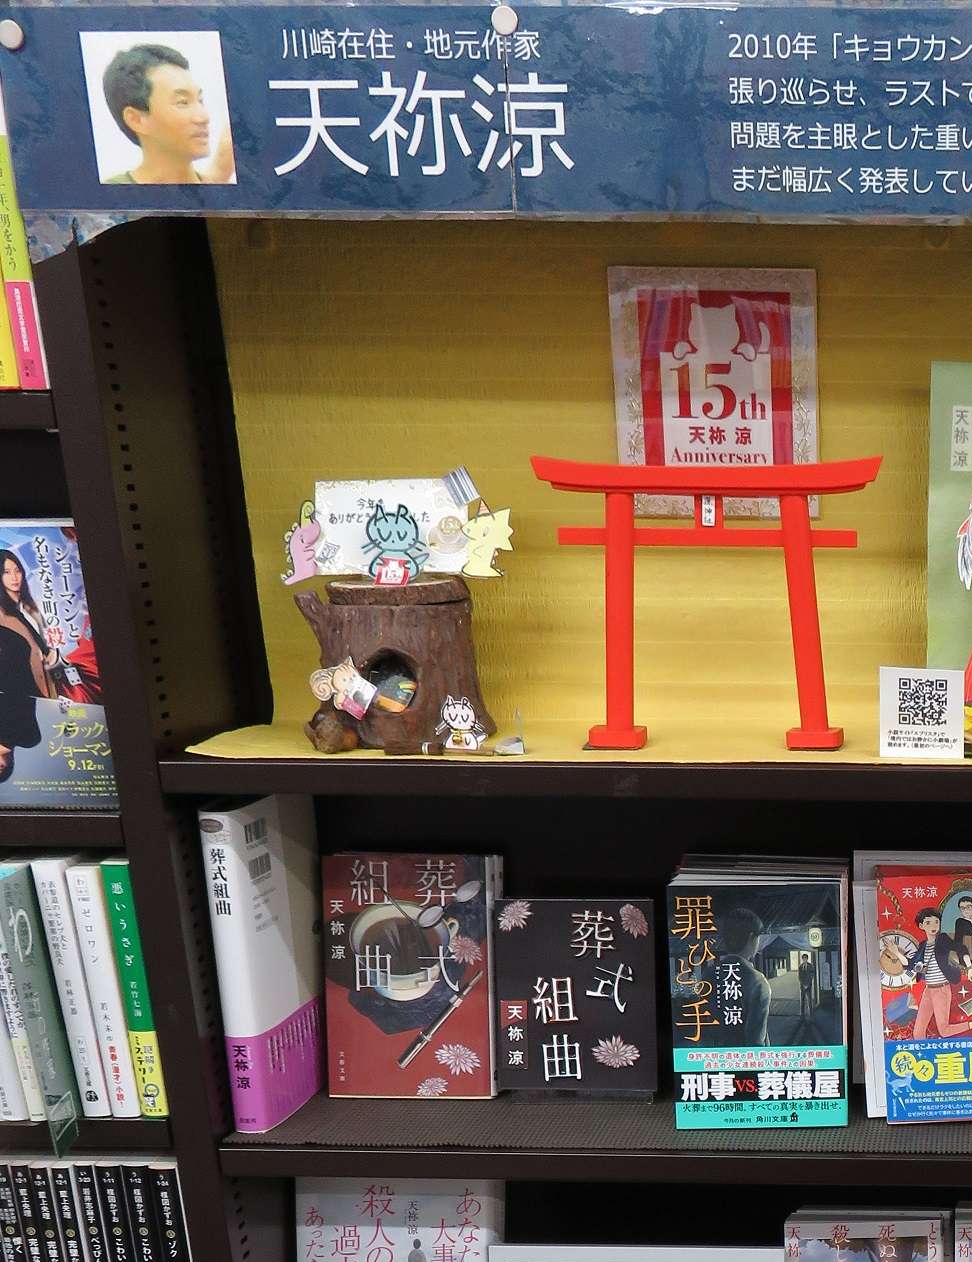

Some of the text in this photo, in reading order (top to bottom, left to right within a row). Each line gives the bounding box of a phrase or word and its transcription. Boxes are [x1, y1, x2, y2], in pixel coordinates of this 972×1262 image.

[281, 28, 541, 61] 川崎在住・地元作家
[267, 70, 574, 178] 天祢涼
[670, 361, 767, 420] 15th
[55, 547, 81, 640] ショーマンと
[48, 740, 112, 759] ショーマン
[51, 720, 109, 739] ブラック・
[67, 759, 94, 771] 9.12
[208, 847, 232, 917] 葬式組曲
[902, 886, 938, 899] 天祢涼
[81, 907, 99, 964] ゼロワン
[111, 881, 134, 967] 悪いうさぎ
[671, 895, 720, 1042] 罪びとの手
[232, 1044, 251, 1089] 天祢涼
